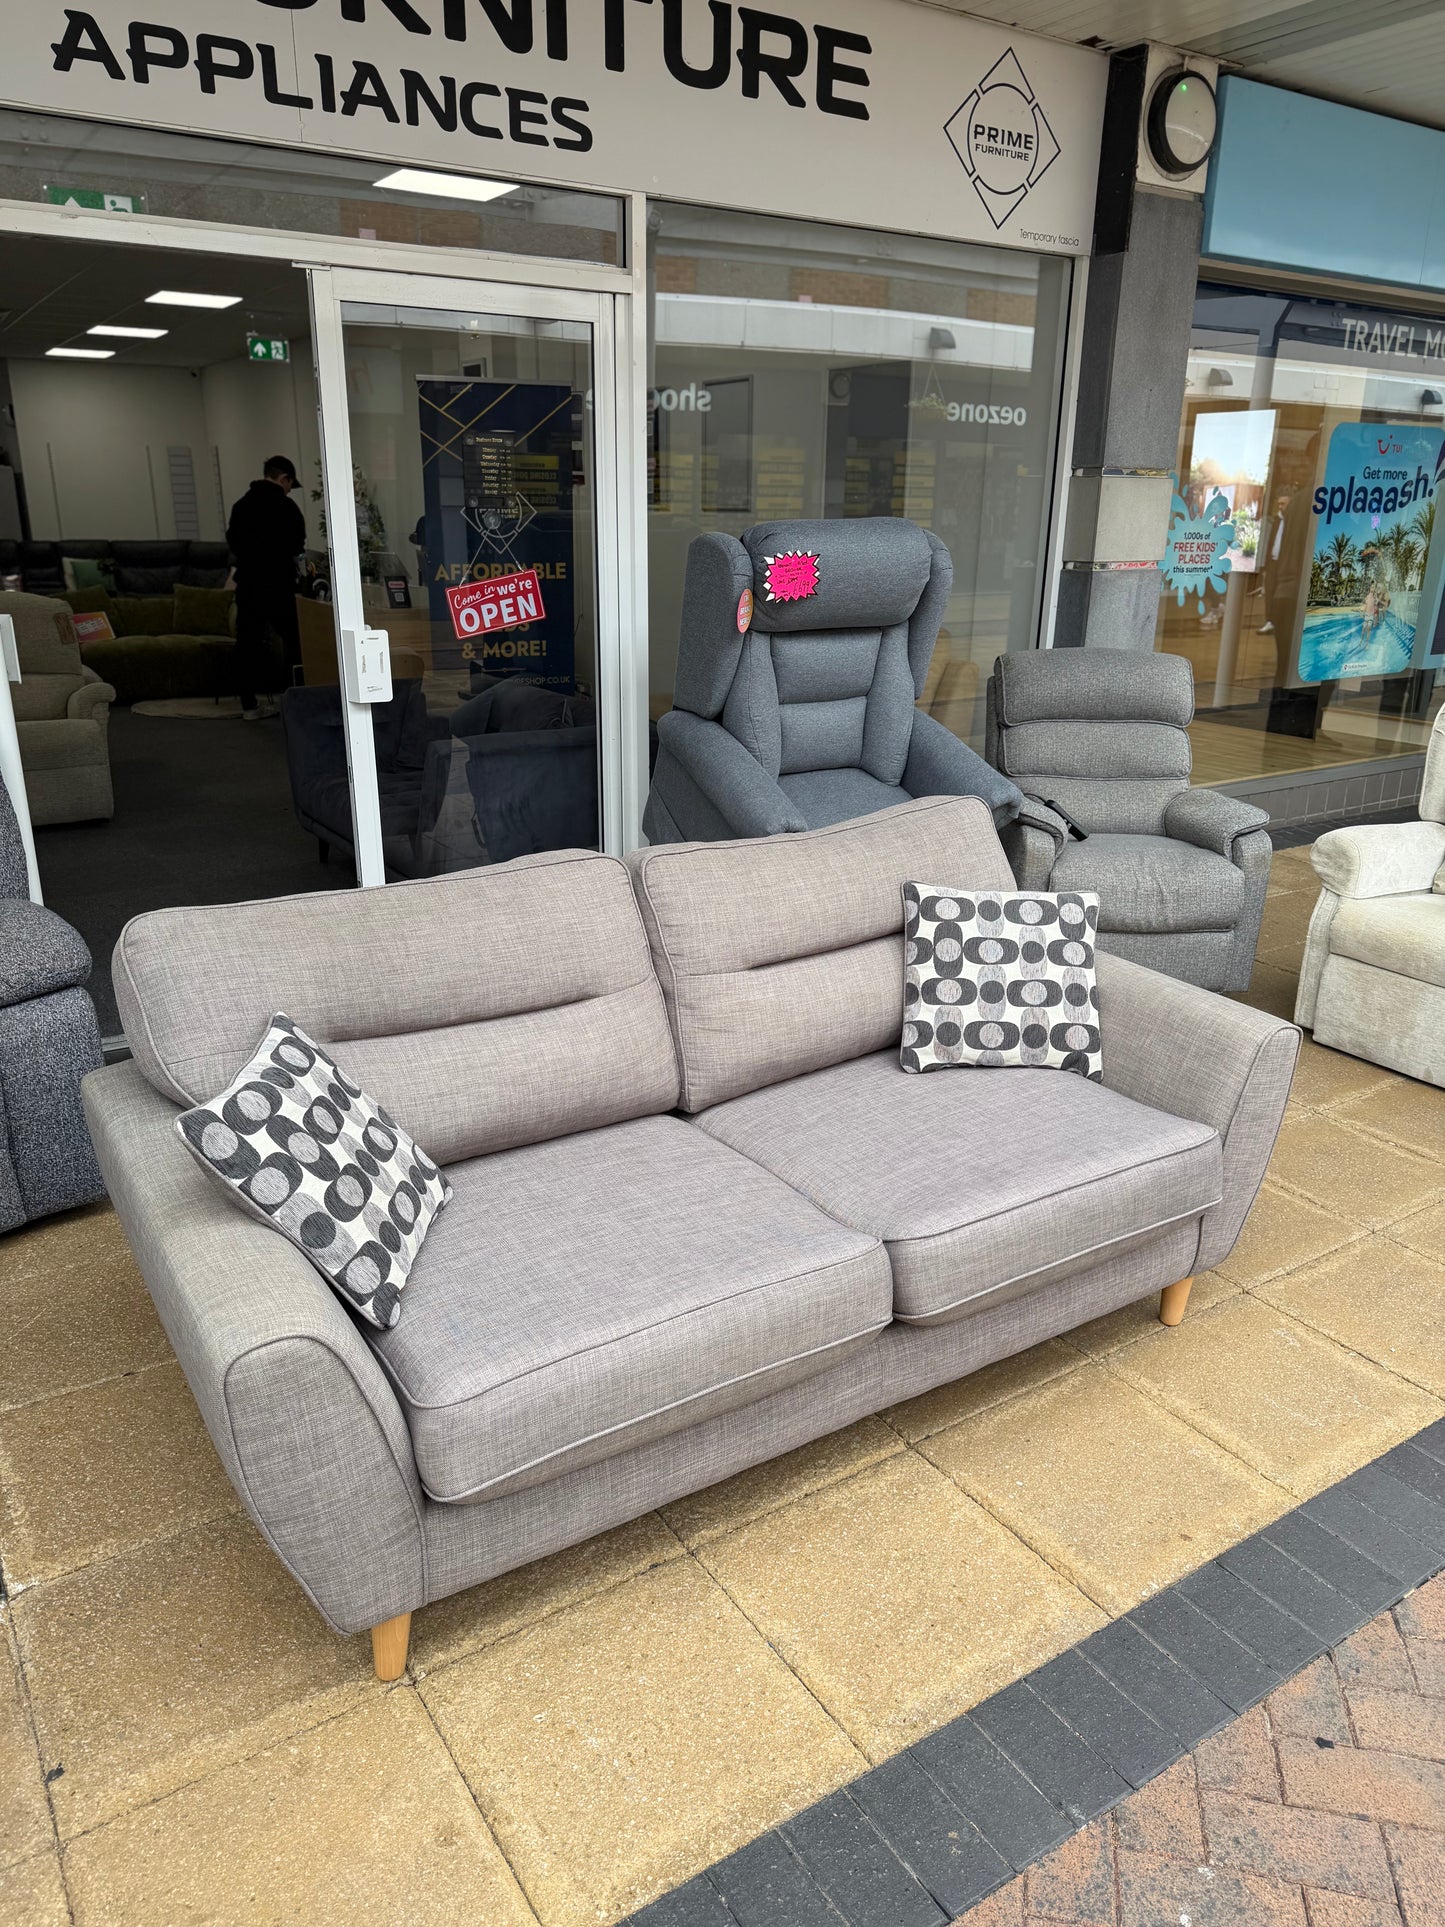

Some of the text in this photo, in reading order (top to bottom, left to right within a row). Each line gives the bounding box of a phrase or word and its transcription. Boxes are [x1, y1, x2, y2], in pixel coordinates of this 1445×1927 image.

[51, 9, 593, 152] APPLIANCES
[973, 124, 1034, 151] PRIME
[975, 143, 1030, 162] FURNITURE
[1019, 228, 1079, 247] Temporary fascia
[1342, 318, 1445, 361] TRAVEL M
[1363, 466, 1408, 480] Get more
[1312, 465, 1434, 524] splaaash.
[1184, 532, 1211, 541] 1,000s of
[1173, 542, 1195, 552] FREE
[1178, 554, 1211, 564] PLACES
[434, 562, 567, 581] AFFORDBLE
[454, 578, 532, 609] Come in we're
[459, 593, 537, 633] OPEN
[461, 640, 547, 660] & MORE!
